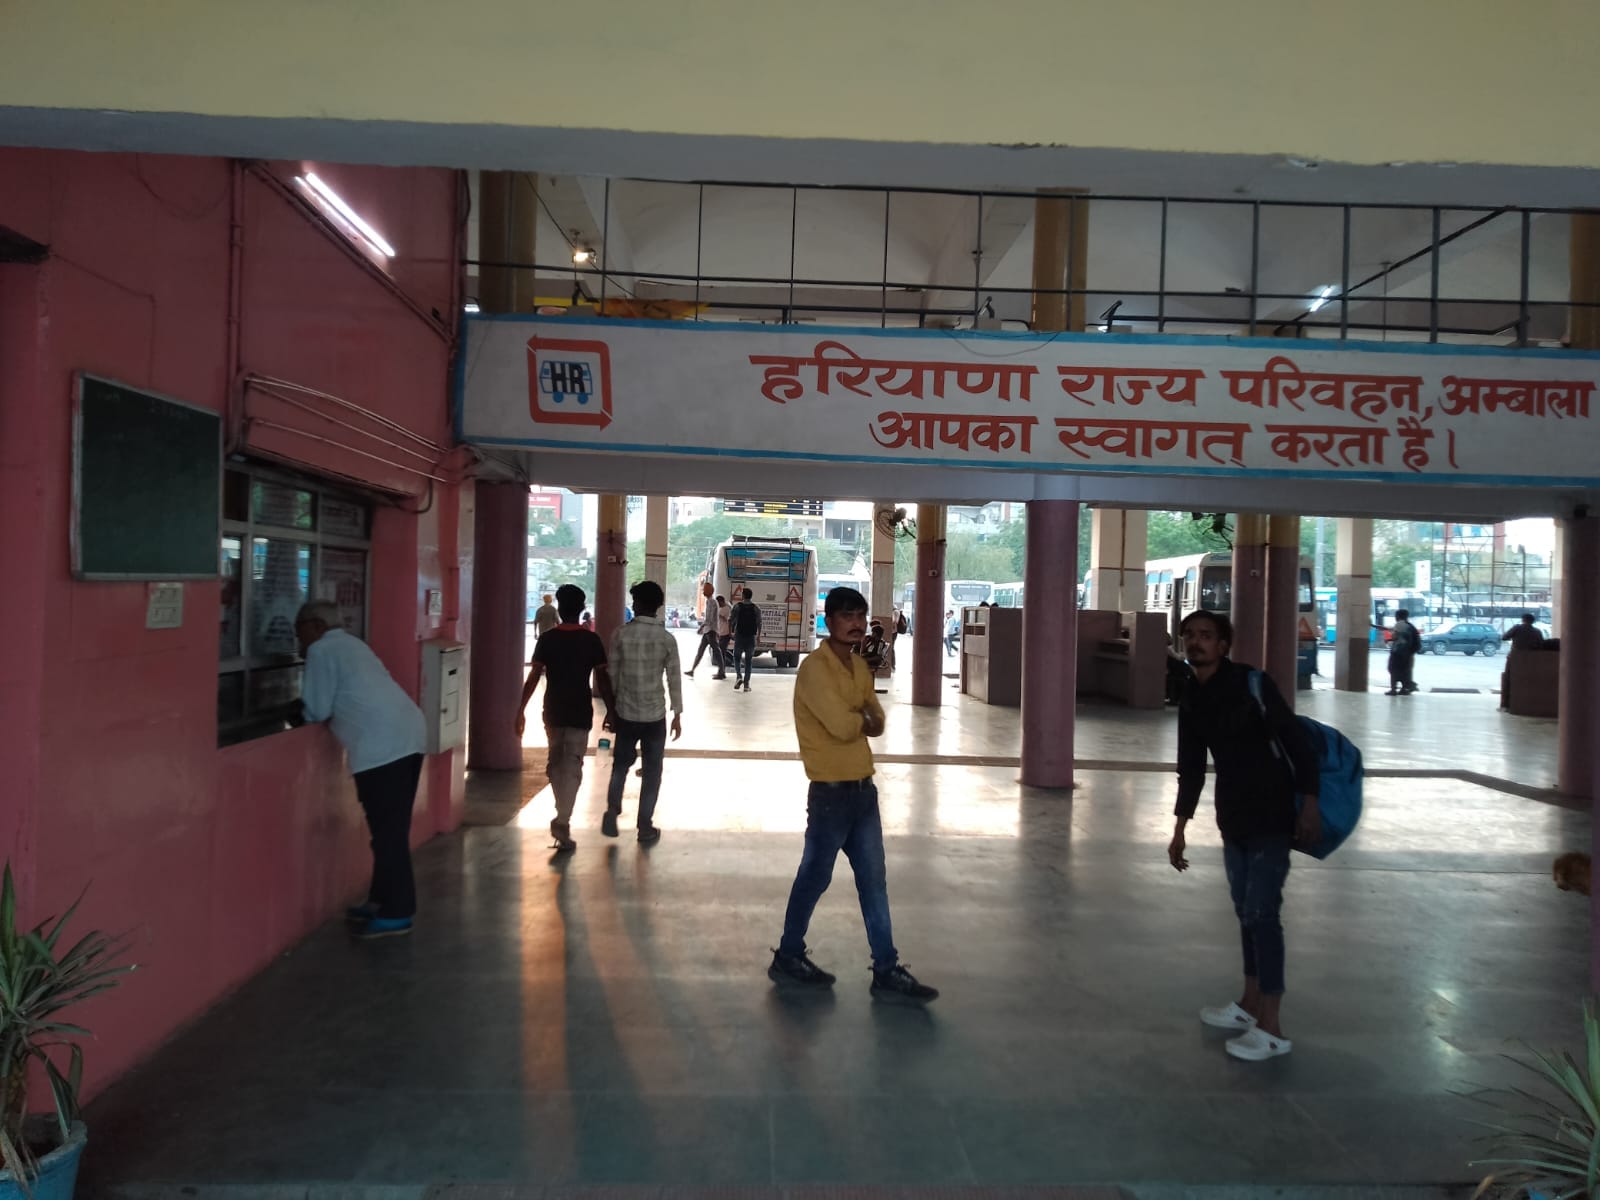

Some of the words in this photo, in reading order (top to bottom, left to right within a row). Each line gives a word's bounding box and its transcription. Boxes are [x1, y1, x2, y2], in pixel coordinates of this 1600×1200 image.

[549, 361, 586, 393] HR
[748, 341, 1040, 403] हरियाणा
[1057, 366, 1207, 407] राज्य
[1438, 375, 1597, 420] अम्बाला
[869, 411, 1040, 454] आपका
[1264, 424, 1391, 468] करता
